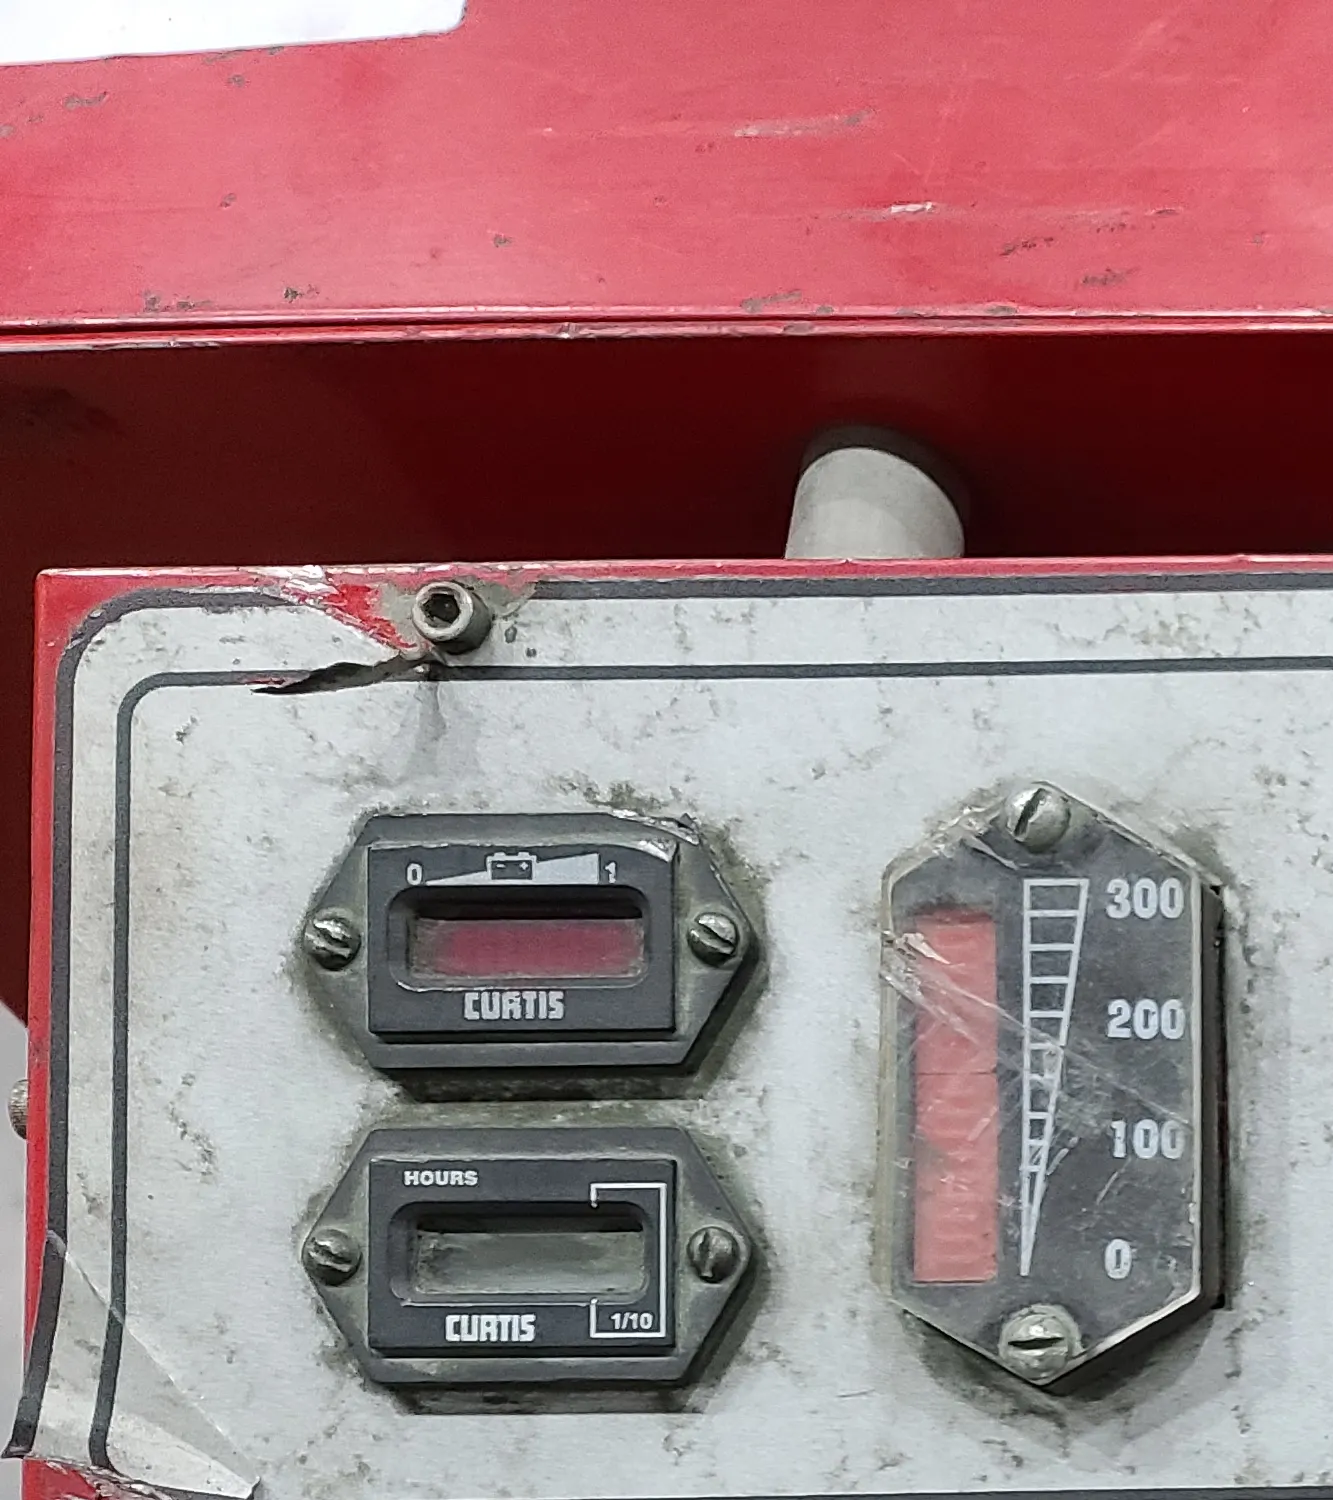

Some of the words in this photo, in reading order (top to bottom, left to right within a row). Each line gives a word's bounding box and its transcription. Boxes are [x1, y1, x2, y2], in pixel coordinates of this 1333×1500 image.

[1105, 877, 1184, 920] 300
[463, 988, 565, 1022] CURTIS
[1107, 998, 1186, 1041] 200
[1110, 1120, 1186, 1160] 100
[403, 1167, 479, 1187] HOURS
[445, 1313, 536, 1344] CURTIS
[610, 1312, 653, 1330] 1/10
